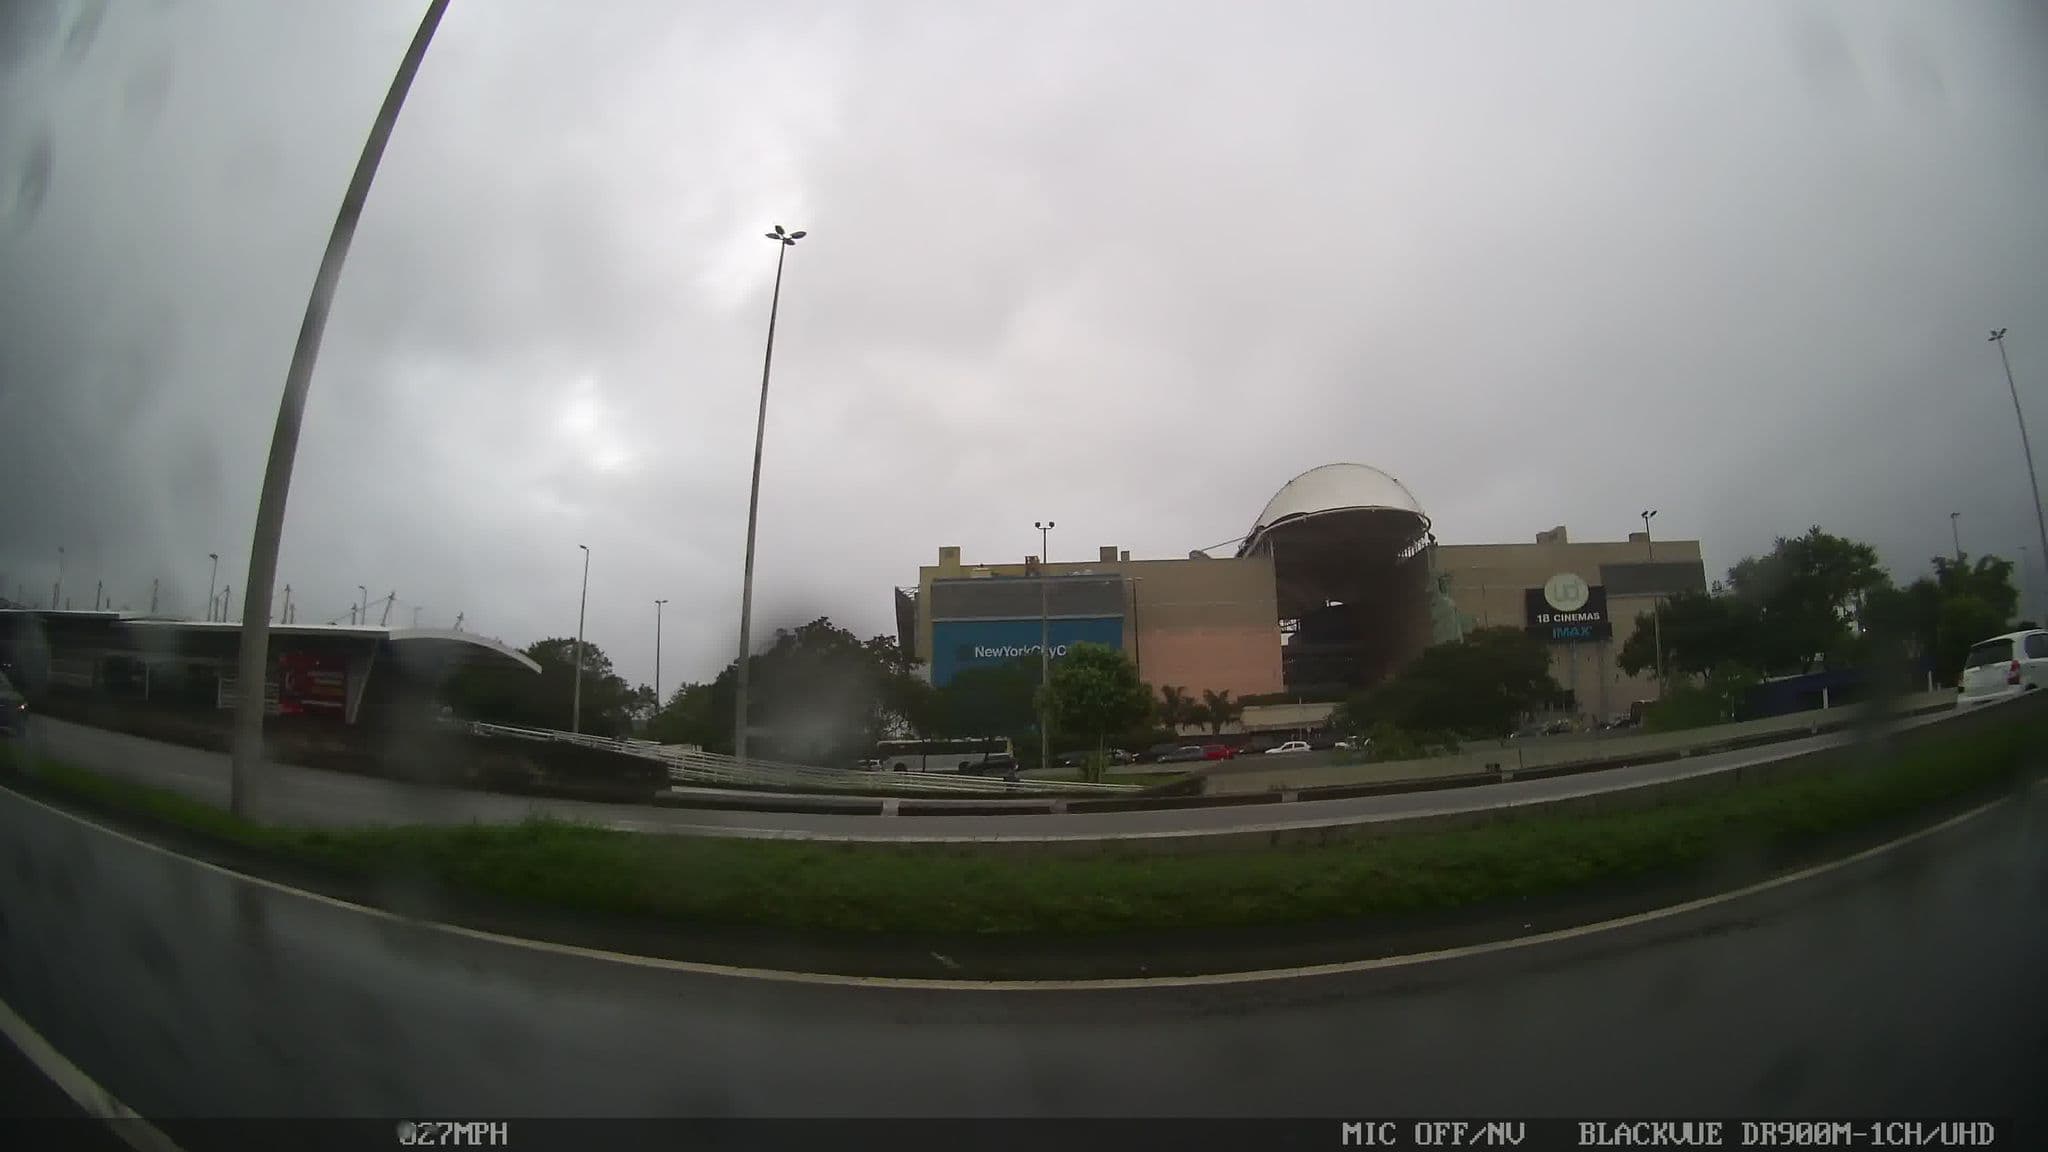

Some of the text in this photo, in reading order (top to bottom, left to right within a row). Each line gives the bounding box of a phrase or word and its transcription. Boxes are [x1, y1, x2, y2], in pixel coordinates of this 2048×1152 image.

[1537, 612, 1601, 624] 18 CINEMAS
[1553, 625, 1592, 640] IMAX
